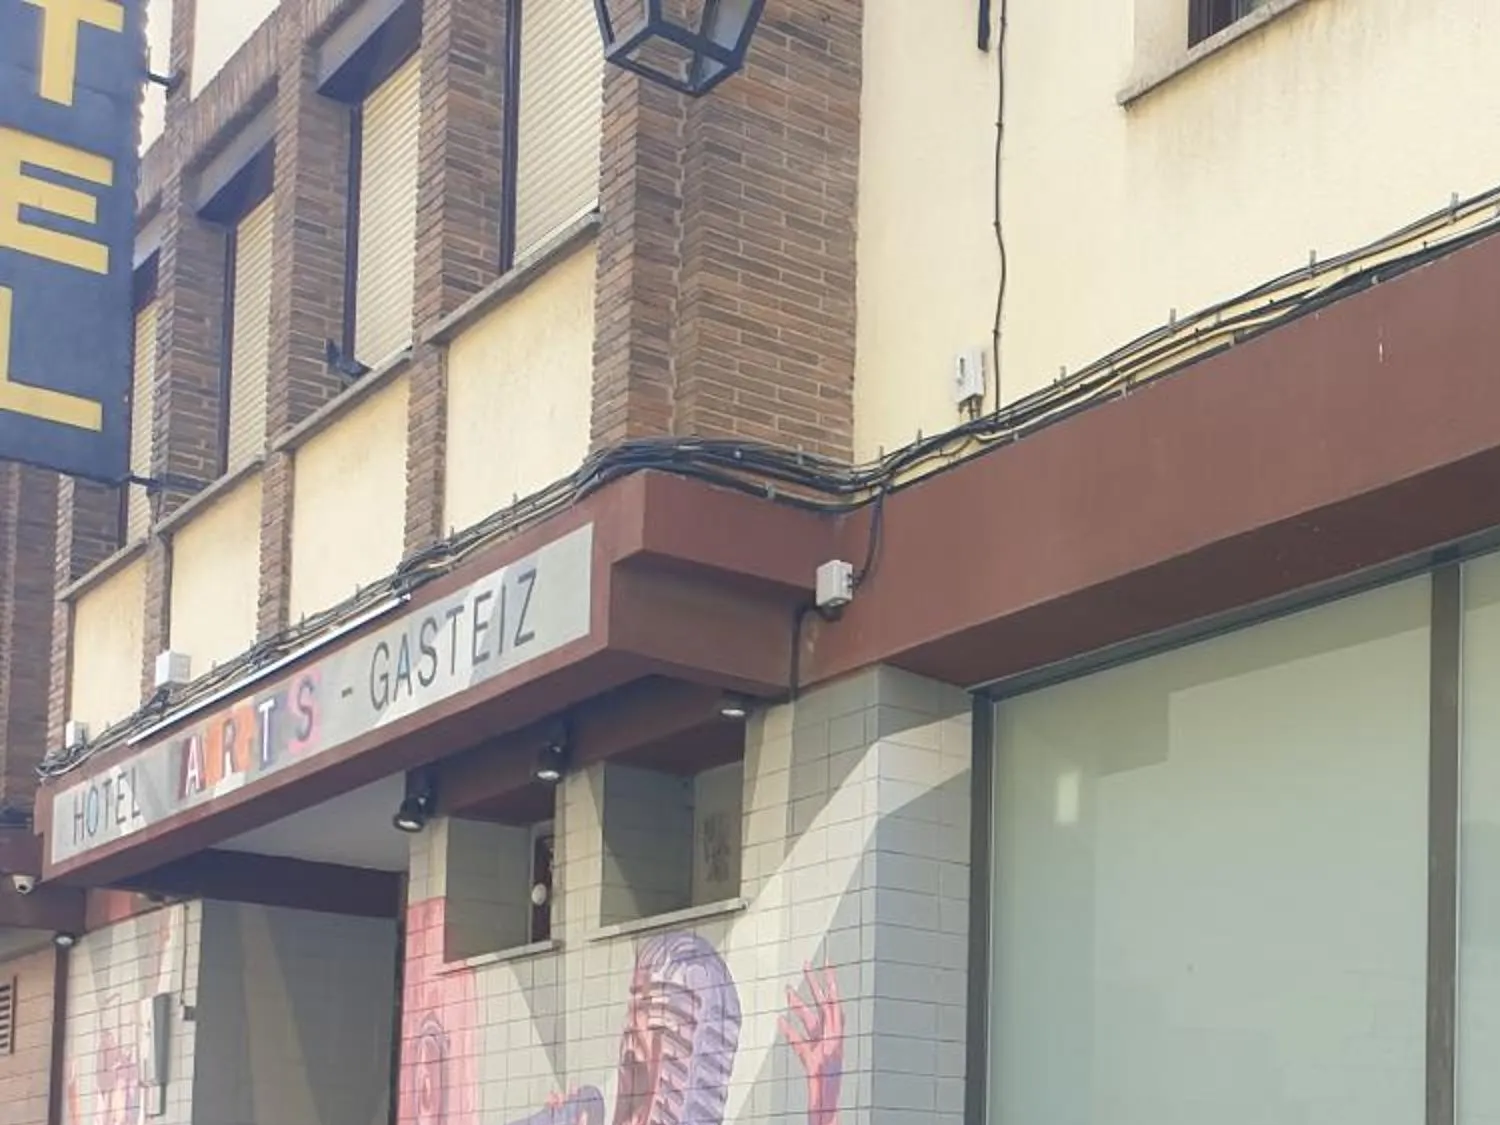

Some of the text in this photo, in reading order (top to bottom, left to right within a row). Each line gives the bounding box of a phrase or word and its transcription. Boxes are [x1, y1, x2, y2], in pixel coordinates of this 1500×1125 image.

[73, 766, 141, 845] HOTEL
[184, 675, 315, 797] ARTS
[369, 568, 538, 711] GASTEIZ
